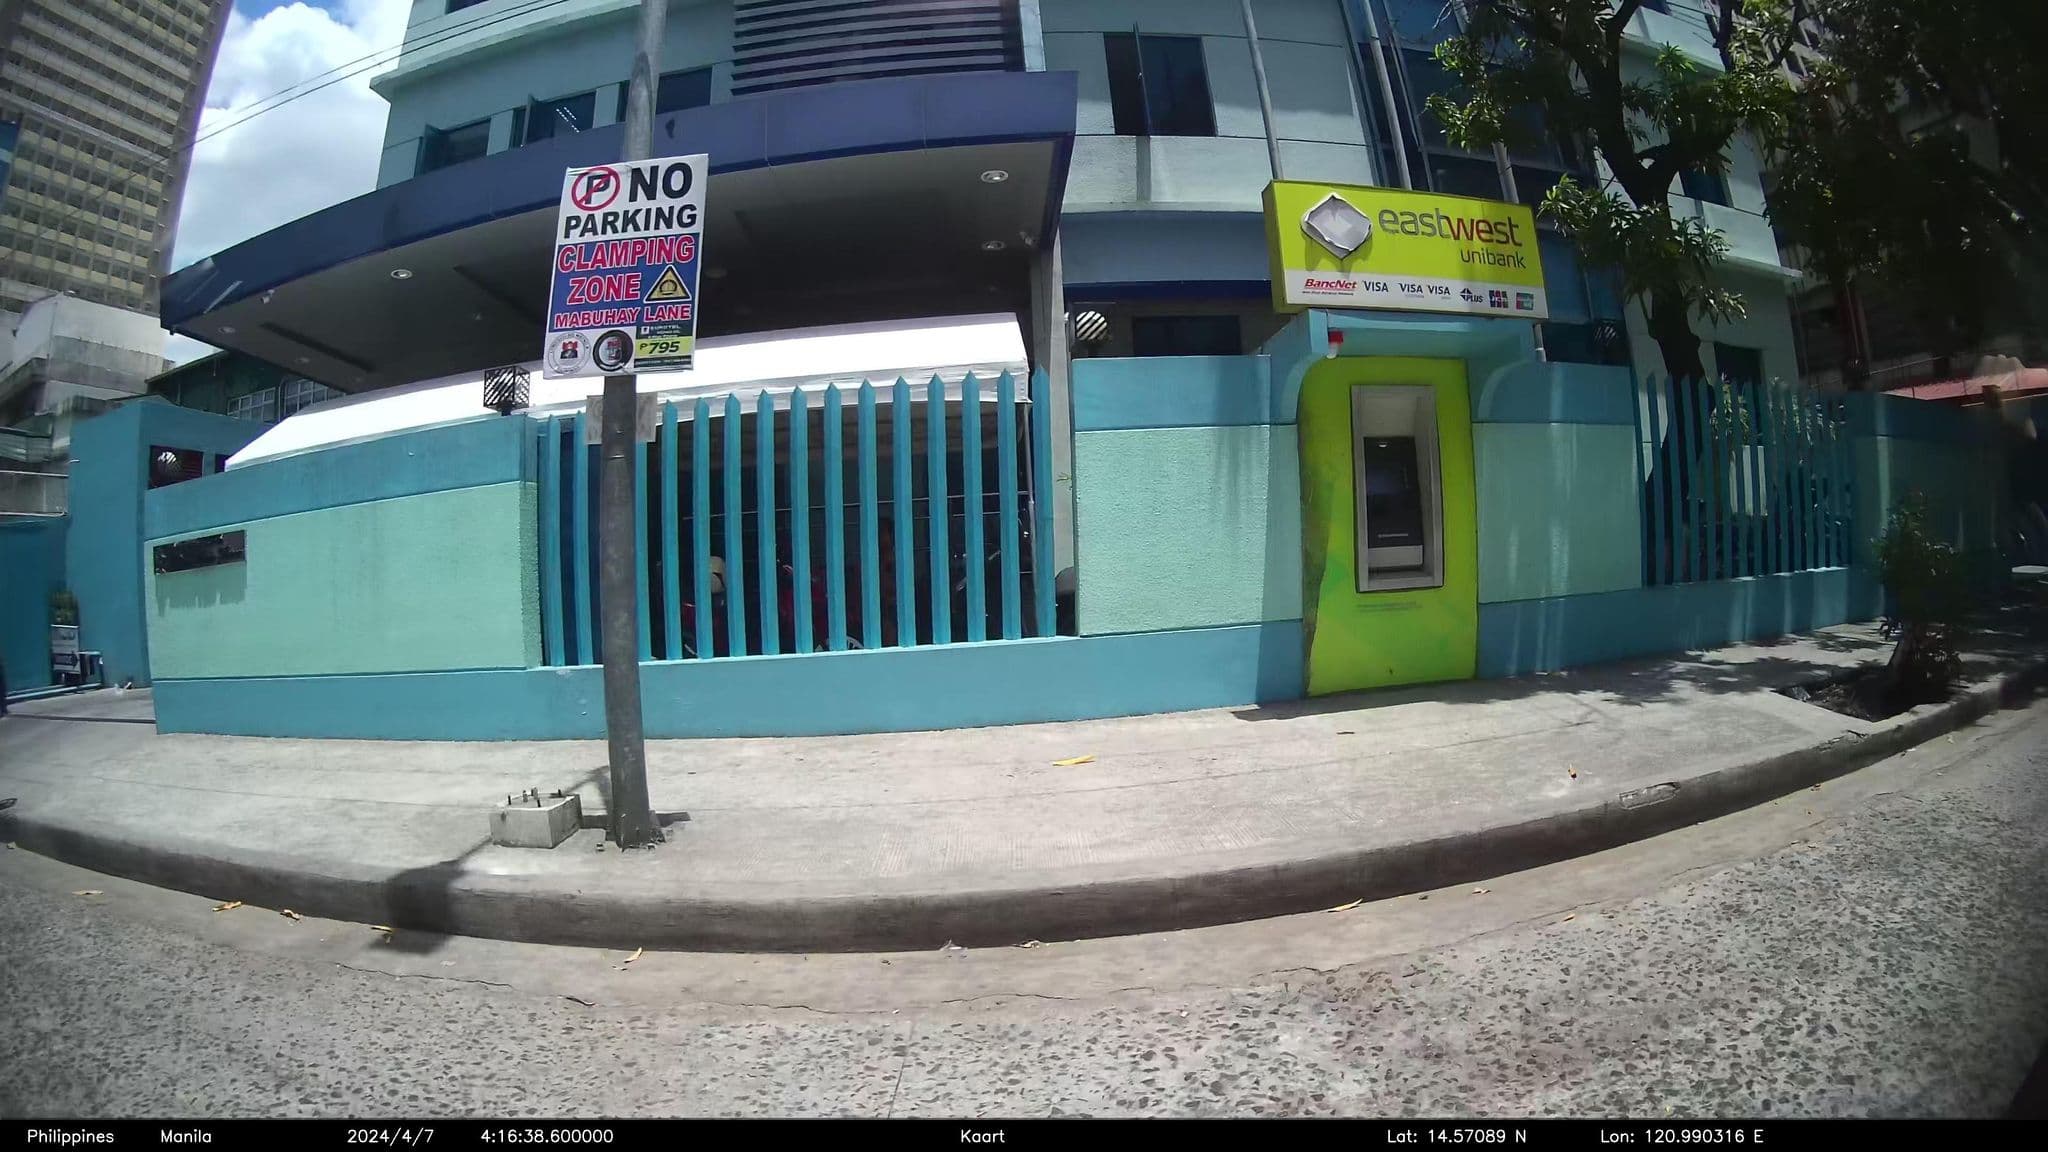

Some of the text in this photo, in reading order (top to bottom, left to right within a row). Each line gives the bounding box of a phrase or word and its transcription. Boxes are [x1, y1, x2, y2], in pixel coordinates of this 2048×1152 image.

[629, 162, 693, 203] NO
[564, 204, 697, 239] PARKING
[1378, 207, 1522, 247] eastwest
[557, 235, 695, 273] CLAMPING
[1460, 248, 1526, 269] unibank
[567, 273, 641, 305] ZONE
[1304, 278, 1358, 290] BancNet
[1363, 280, 1389, 293] VISA
[1398, 282, 1424, 294] VISA
[1427, 284, 1451, 296] VISA
[1467, 294, 1484, 303] PLUS
[554, 304, 692, 329] MABUHAY LANE
